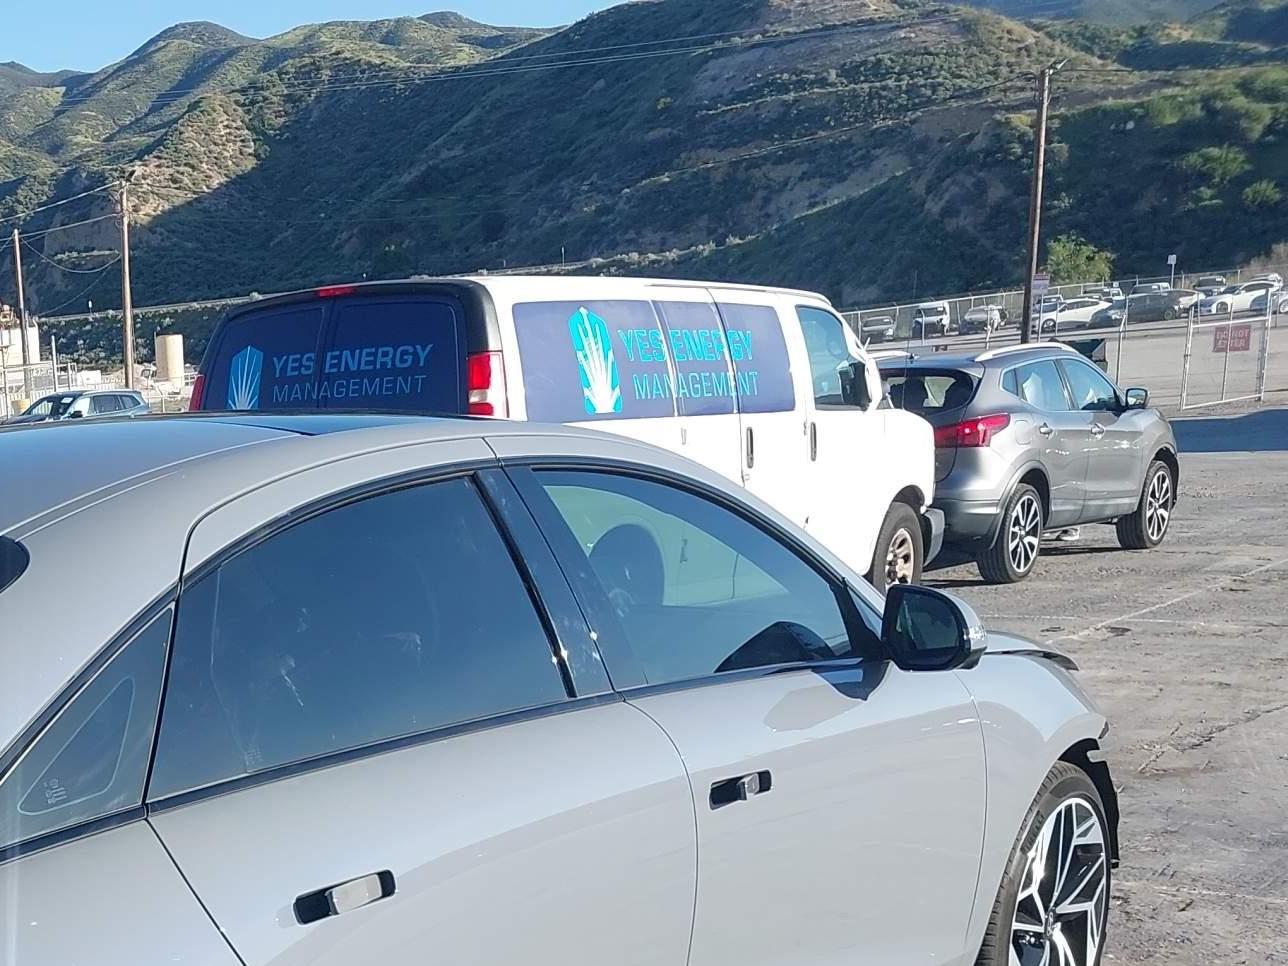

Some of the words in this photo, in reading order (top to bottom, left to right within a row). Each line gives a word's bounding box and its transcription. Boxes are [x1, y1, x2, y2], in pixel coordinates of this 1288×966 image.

[273, 352, 317, 378] YES
[324, 343, 433, 374] ENERGY
[618, 330, 667, 362] YES
[272, 375, 426, 404] MANAGEMENT
